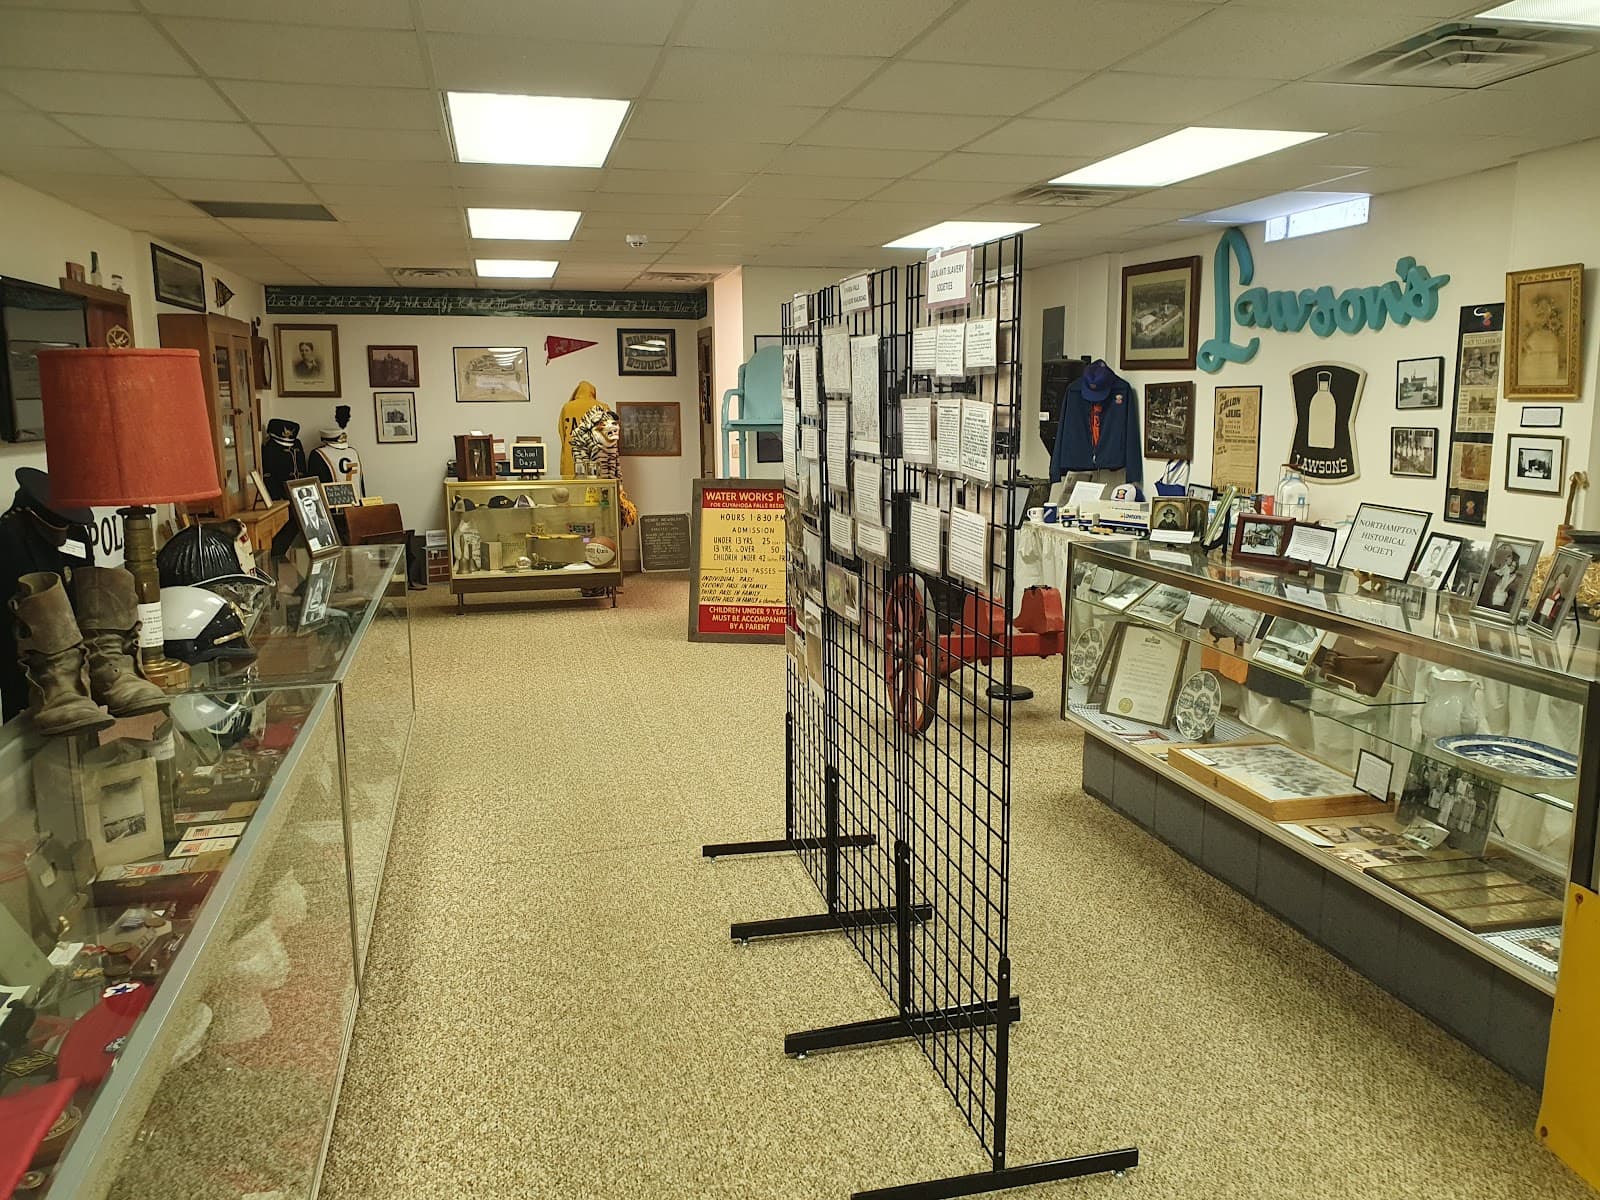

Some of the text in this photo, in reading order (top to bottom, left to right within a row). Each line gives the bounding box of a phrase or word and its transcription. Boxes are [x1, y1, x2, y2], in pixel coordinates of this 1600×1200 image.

[947, 263, 965, 275] SLAVERY
[1197, 227, 1451, 373] Lawson's
[1225, 409, 1241, 418] JUG
[514, 449, 539, 458] School
[519, 458, 537, 467] Days
[705, 492, 737, 501] WATER
[739, 492, 774, 502] WORKS
[720, 513, 745, 522] HOURS
[1360, 519, 1419, 536] NORTHAMPTON
[713, 536, 732, 544] UNDER
[735, 537, 741, 545] 13
[762, 537, 771, 545] 25
[1361, 532, 1407, 547] HISTORICAL
[740, 545, 755, 553] OVER
[770, 546, 780, 554] 50
[1364, 543, 1395, 557] SOCIETY
[740, 554, 756, 562] UNDER
[724, 566, 776, 575] SEASON PASSES
[708, 606, 787, 616] CHILDREN UNDER 9 YEA
[712, 614, 731, 622] MUST
[729, 622, 738, 630] BY
[745, 623, 771, 631] PARENT
